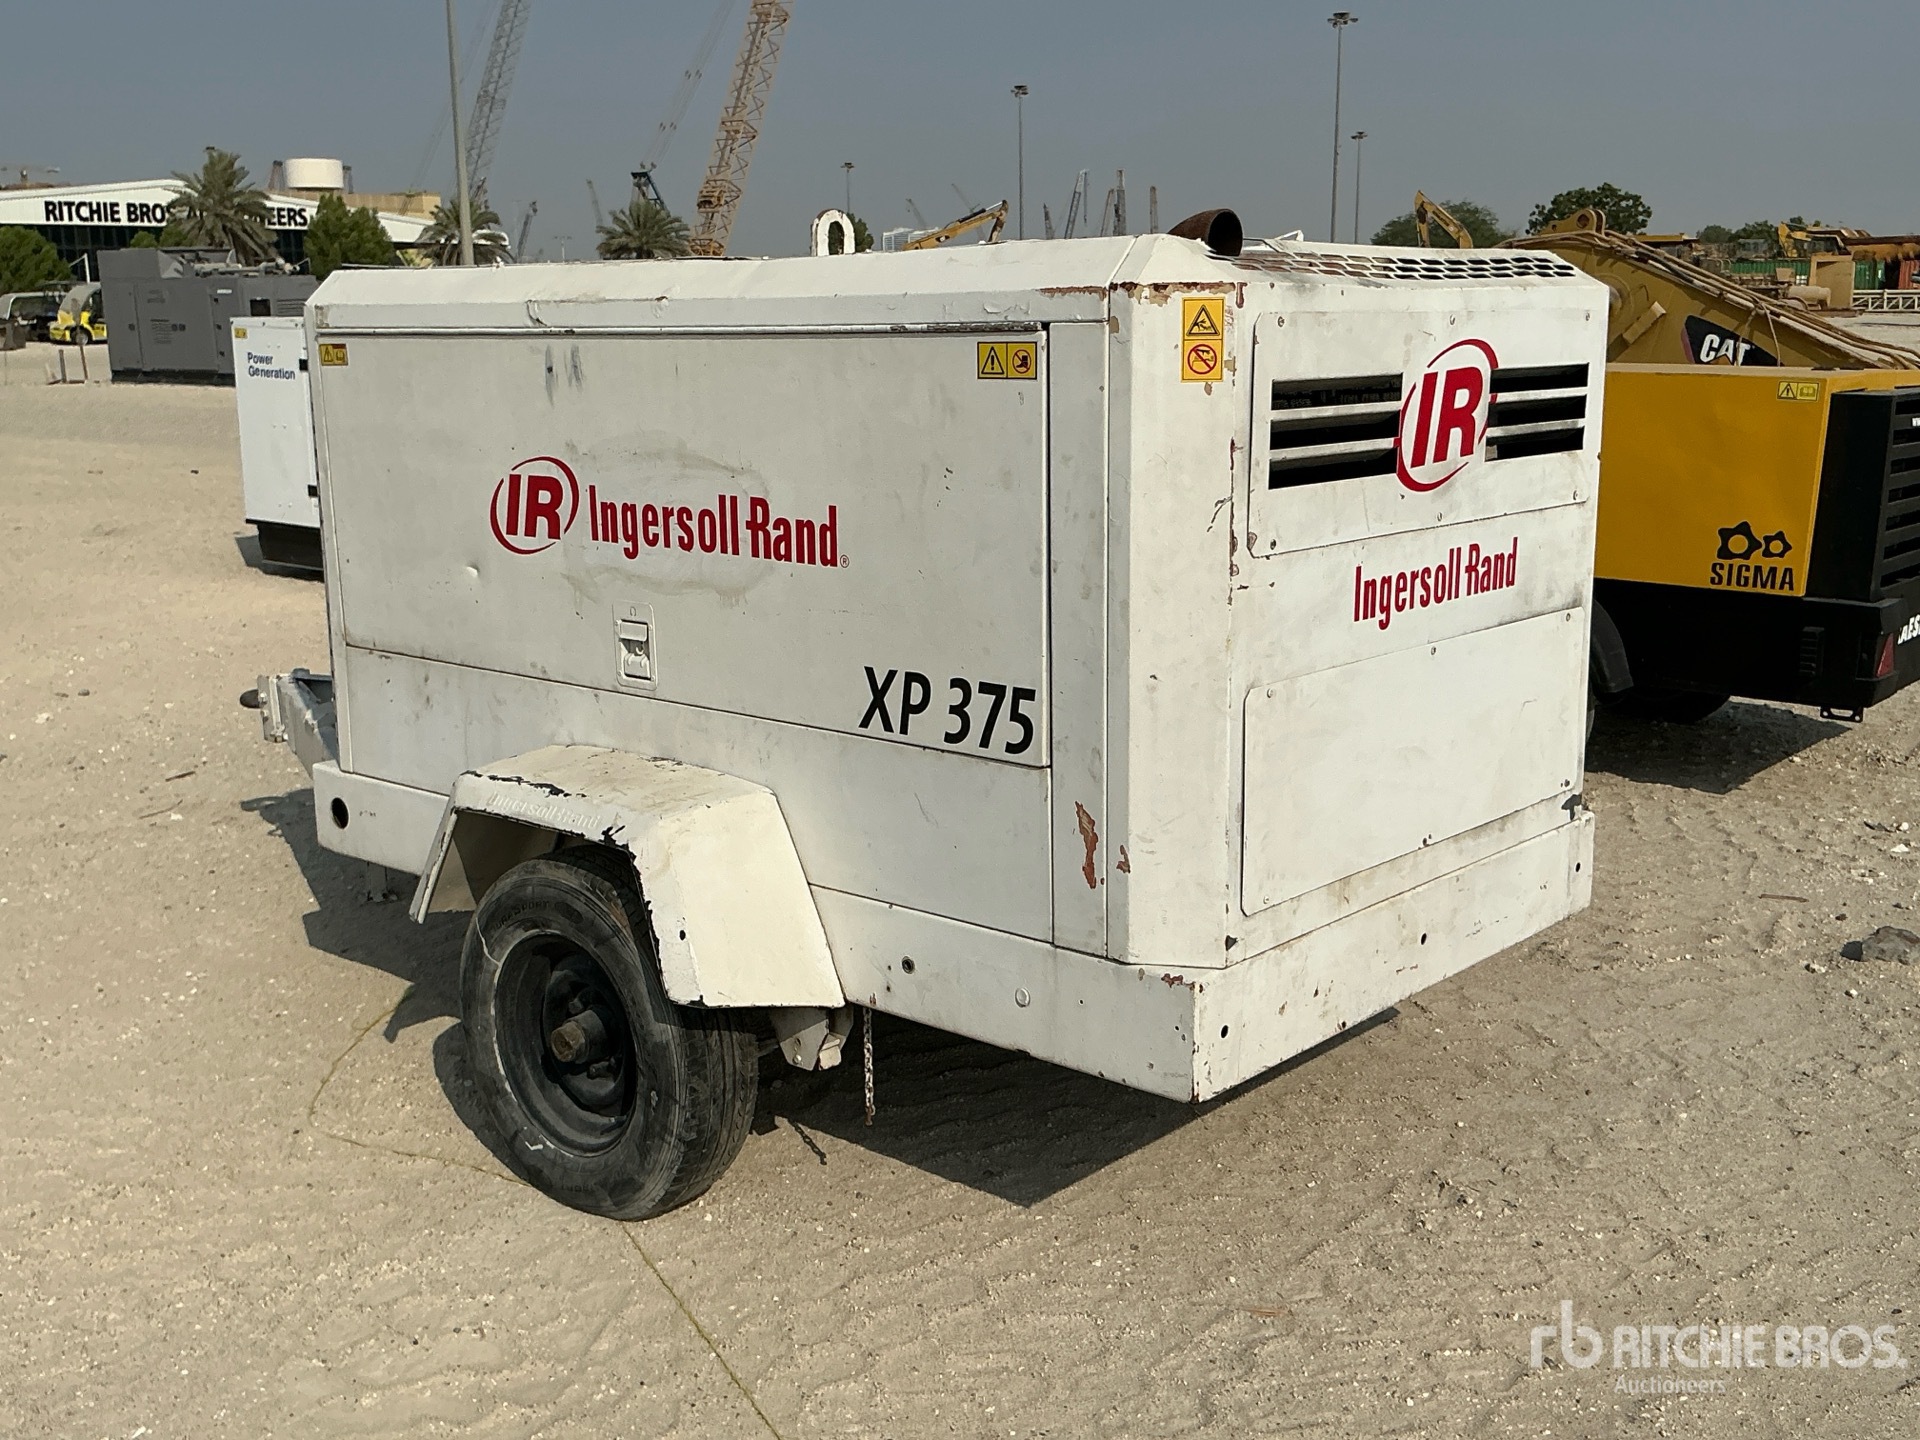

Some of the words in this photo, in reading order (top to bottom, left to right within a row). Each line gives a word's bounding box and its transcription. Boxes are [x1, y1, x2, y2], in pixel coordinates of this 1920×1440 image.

[44, 200, 121, 223] RITCHIE
[247, 351, 273, 365] Power
[1700, 334, 1751, 366] CAT
[248, 365, 296, 380] Generation
[1410, 366, 1484, 468] IR
[506, 474, 563, 539] IR
[1709, 562, 1795, 592] SIGMA
[1897, 614, 1920, 645] AES
[858, 666, 932, 736] XP
[943, 677, 1036, 755] 375
